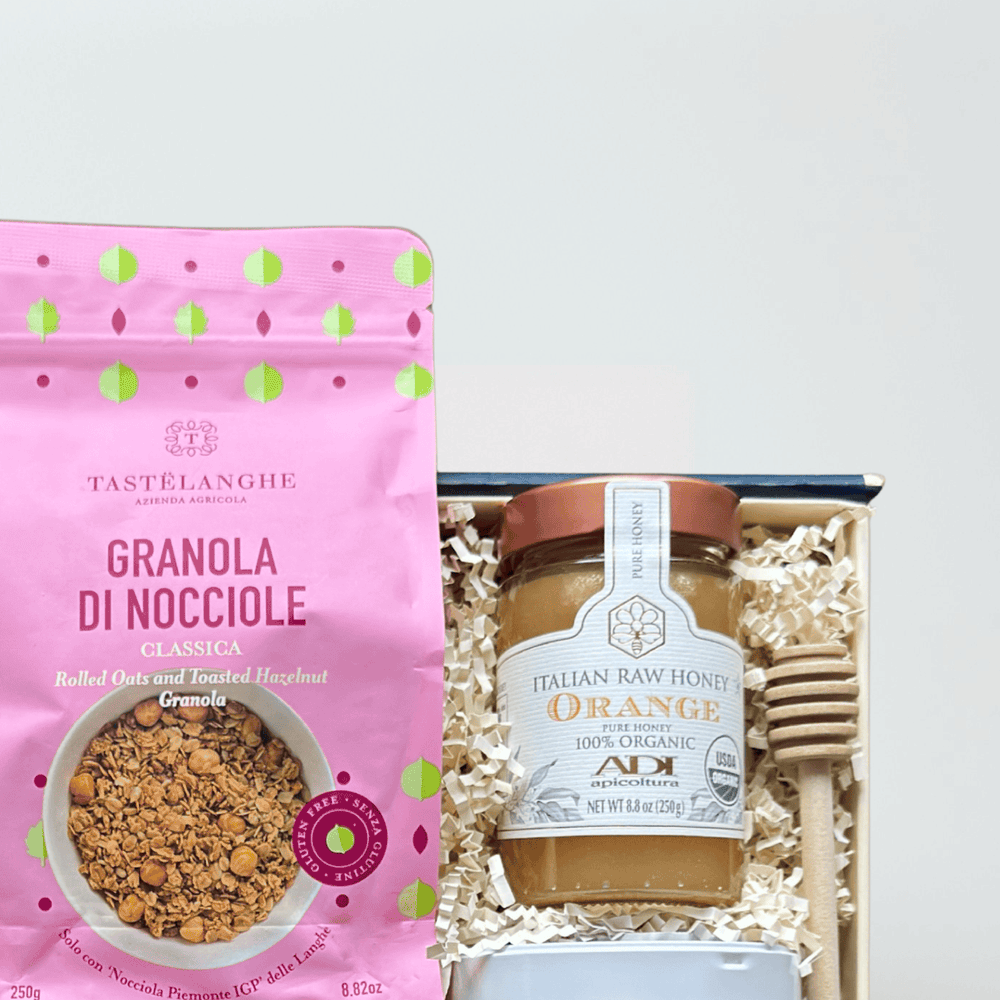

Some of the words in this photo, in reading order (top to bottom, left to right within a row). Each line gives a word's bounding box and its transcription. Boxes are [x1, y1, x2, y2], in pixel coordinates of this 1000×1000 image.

[87, 472, 296, 493] TASTËLANGHE
[135, 497, 186, 506] AZIENDA
[189, 496, 248, 505] AGRICOLA
[631, 501, 644, 546] HONEY
[106, 537, 278, 578] GRANOLA
[631, 549, 644, 579] PURE
[78, 590, 112, 632] DI
[127, 585, 307, 631] NOCCIOLE
[140, 640, 243, 657] CLASSICA
[54, 671, 108, 688] Rolled
[111, 670, 150, 687] Oats
[153, 669, 185, 685] and
[189, 669, 251, 685] Toasted
[255, 668, 328, 687] Hazelnut
[533, 669, 609, 692] ITALIAN
[618, 669, 664, 685] RAW
[671, 670, 729, 691] HONEY
[159, 691, 227, 709] Granola
[547, 692, 720, 723] ORANGE
[602, 724, 630, 733] PURE
[633, 723, 672, 732] HONEY
[575, 735, 615, 750] 100%
[618, 735, 696, 750] ORGANIC
[590, 755, 679, 778] ADI
[590, 778, 680, 788] apicoltura
[306, 796, 339, 818] FREE
[352, 799, 382, 836] SENZA
[588, 800, 606, 814] NET
[608, 800, 625, 814] WT
[626, 800, 640, 813] 8.8
[642, 803, 653, 813] oz
[655, 799, 685, 816] (250g)
[297, 820, 320, 873] GLUTEN
[335, 841, 382, 881] GLUTINE
[58, 928, 82, 955] Solo
[82, 954, 104, 973] con
[266, 962, 296, 985] delle
[292, 925, 332, 967] Langhe
[340, 980, 383, 998] 8.82oz
